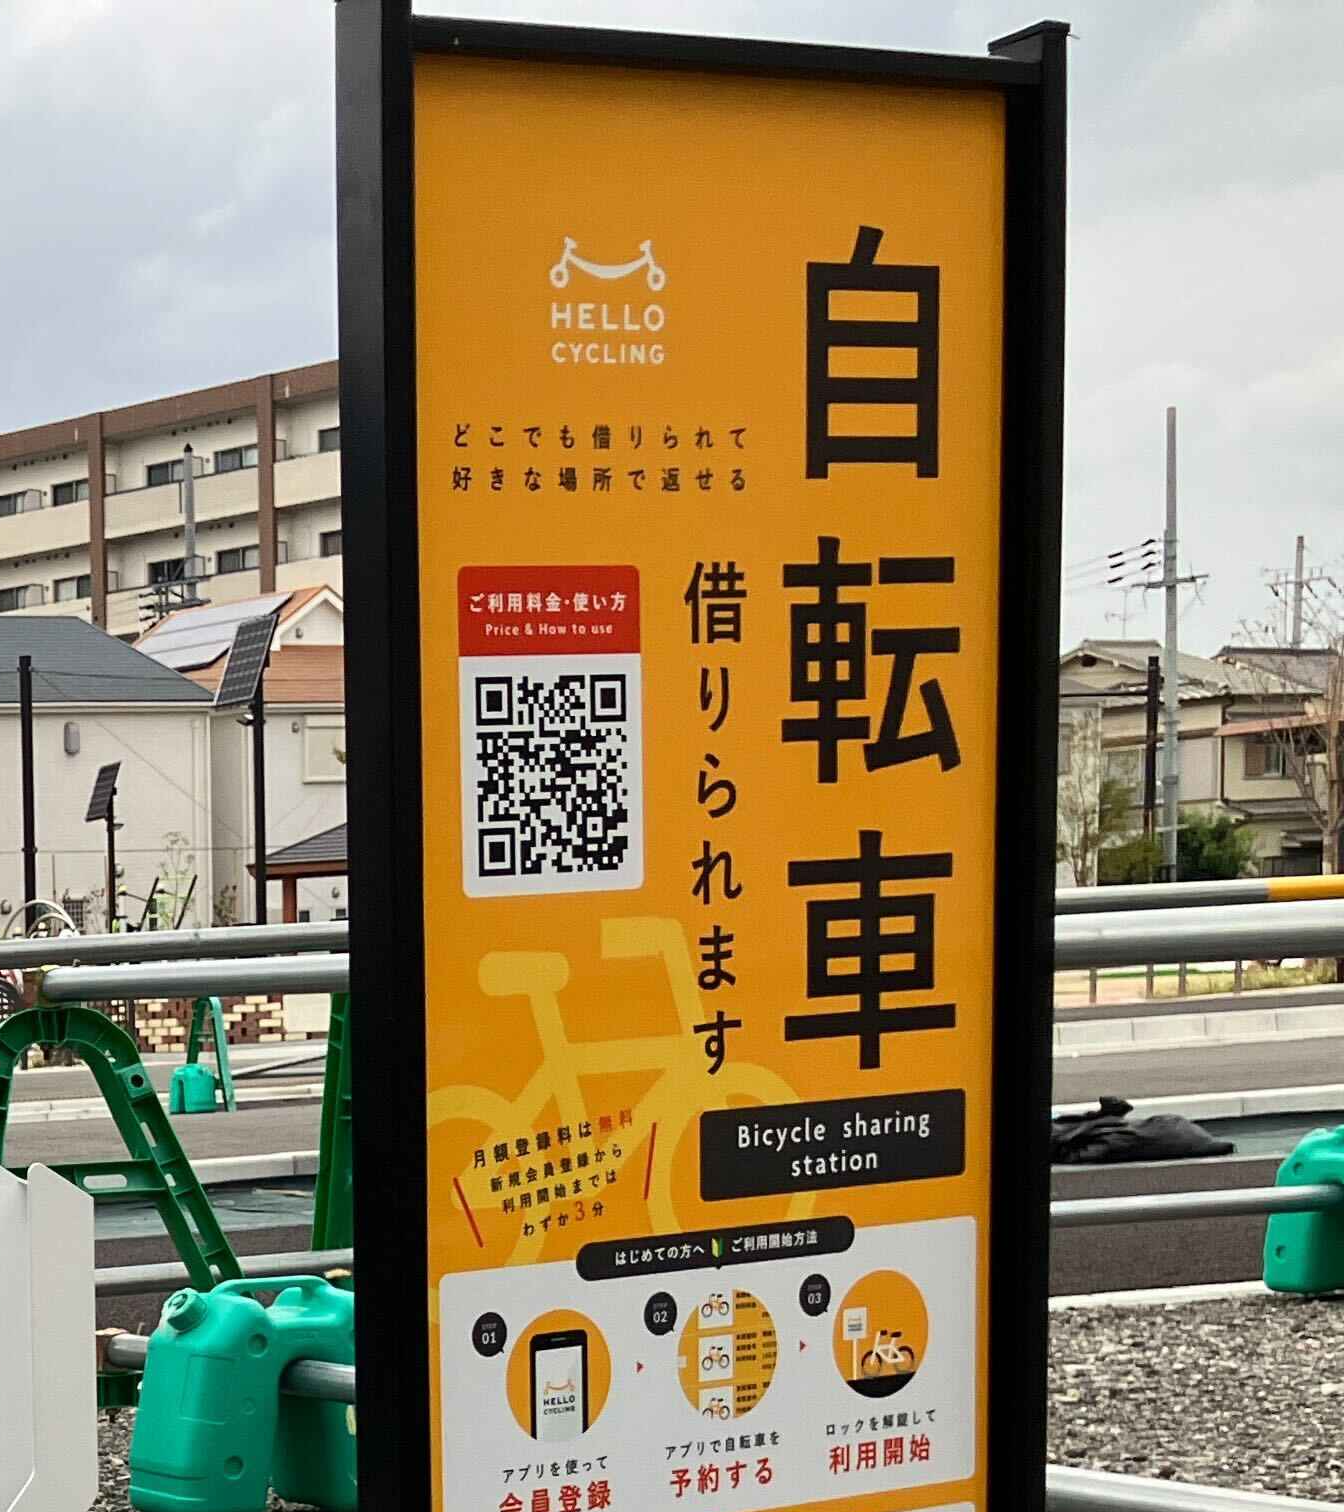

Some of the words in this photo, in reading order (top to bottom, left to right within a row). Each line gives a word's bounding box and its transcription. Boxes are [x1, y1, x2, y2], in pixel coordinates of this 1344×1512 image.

[550, 302, 666, 332] HELLO
[550, 342, 666, 365] CYCLING
[453, 424, 747, 450] どこでも借りられて
[452, 466, 747, 492] 好きな場所で返せる
[485, 624, 519, 636] Price
[524, 623, 533, 636] &
[538, 623, 568, 635] How
[572, 624, 586, 635] to
[591, 624, 613, 635] use
[781, 224, 961, 1071] 自転車
[683, 560, 748, 1075] 借りられます
[737, 1117, 826, 1152] Bicycle
[843, 1111, 930, 1138] sharing
[490, 1143, 623, 1192] 新規会員登録から
[791, 1150, 878, 1177] station
[502, 1169, 617, 1215] 利用開始までは
[522, 1201, 604, 1237] わずか3分
[615, 1244, 705, 1266] はじめての方へ
[731, 1230, 819, 1253] ご利用開始方法
[807, 1292, 822, 1305] 03
[653, 1310, 668, 1323] 02
[481, 1331, 497, 1345] 01
[543, 1394, 576, 1406] HELLO
[665, 1430, 781, 1460] アプリで自転車を
[828, 1433, 931, 1475] 利用開始
[502, 1455, 608, 1484] アプリを使って
[669, 1456, 773, 1498] 予約する
